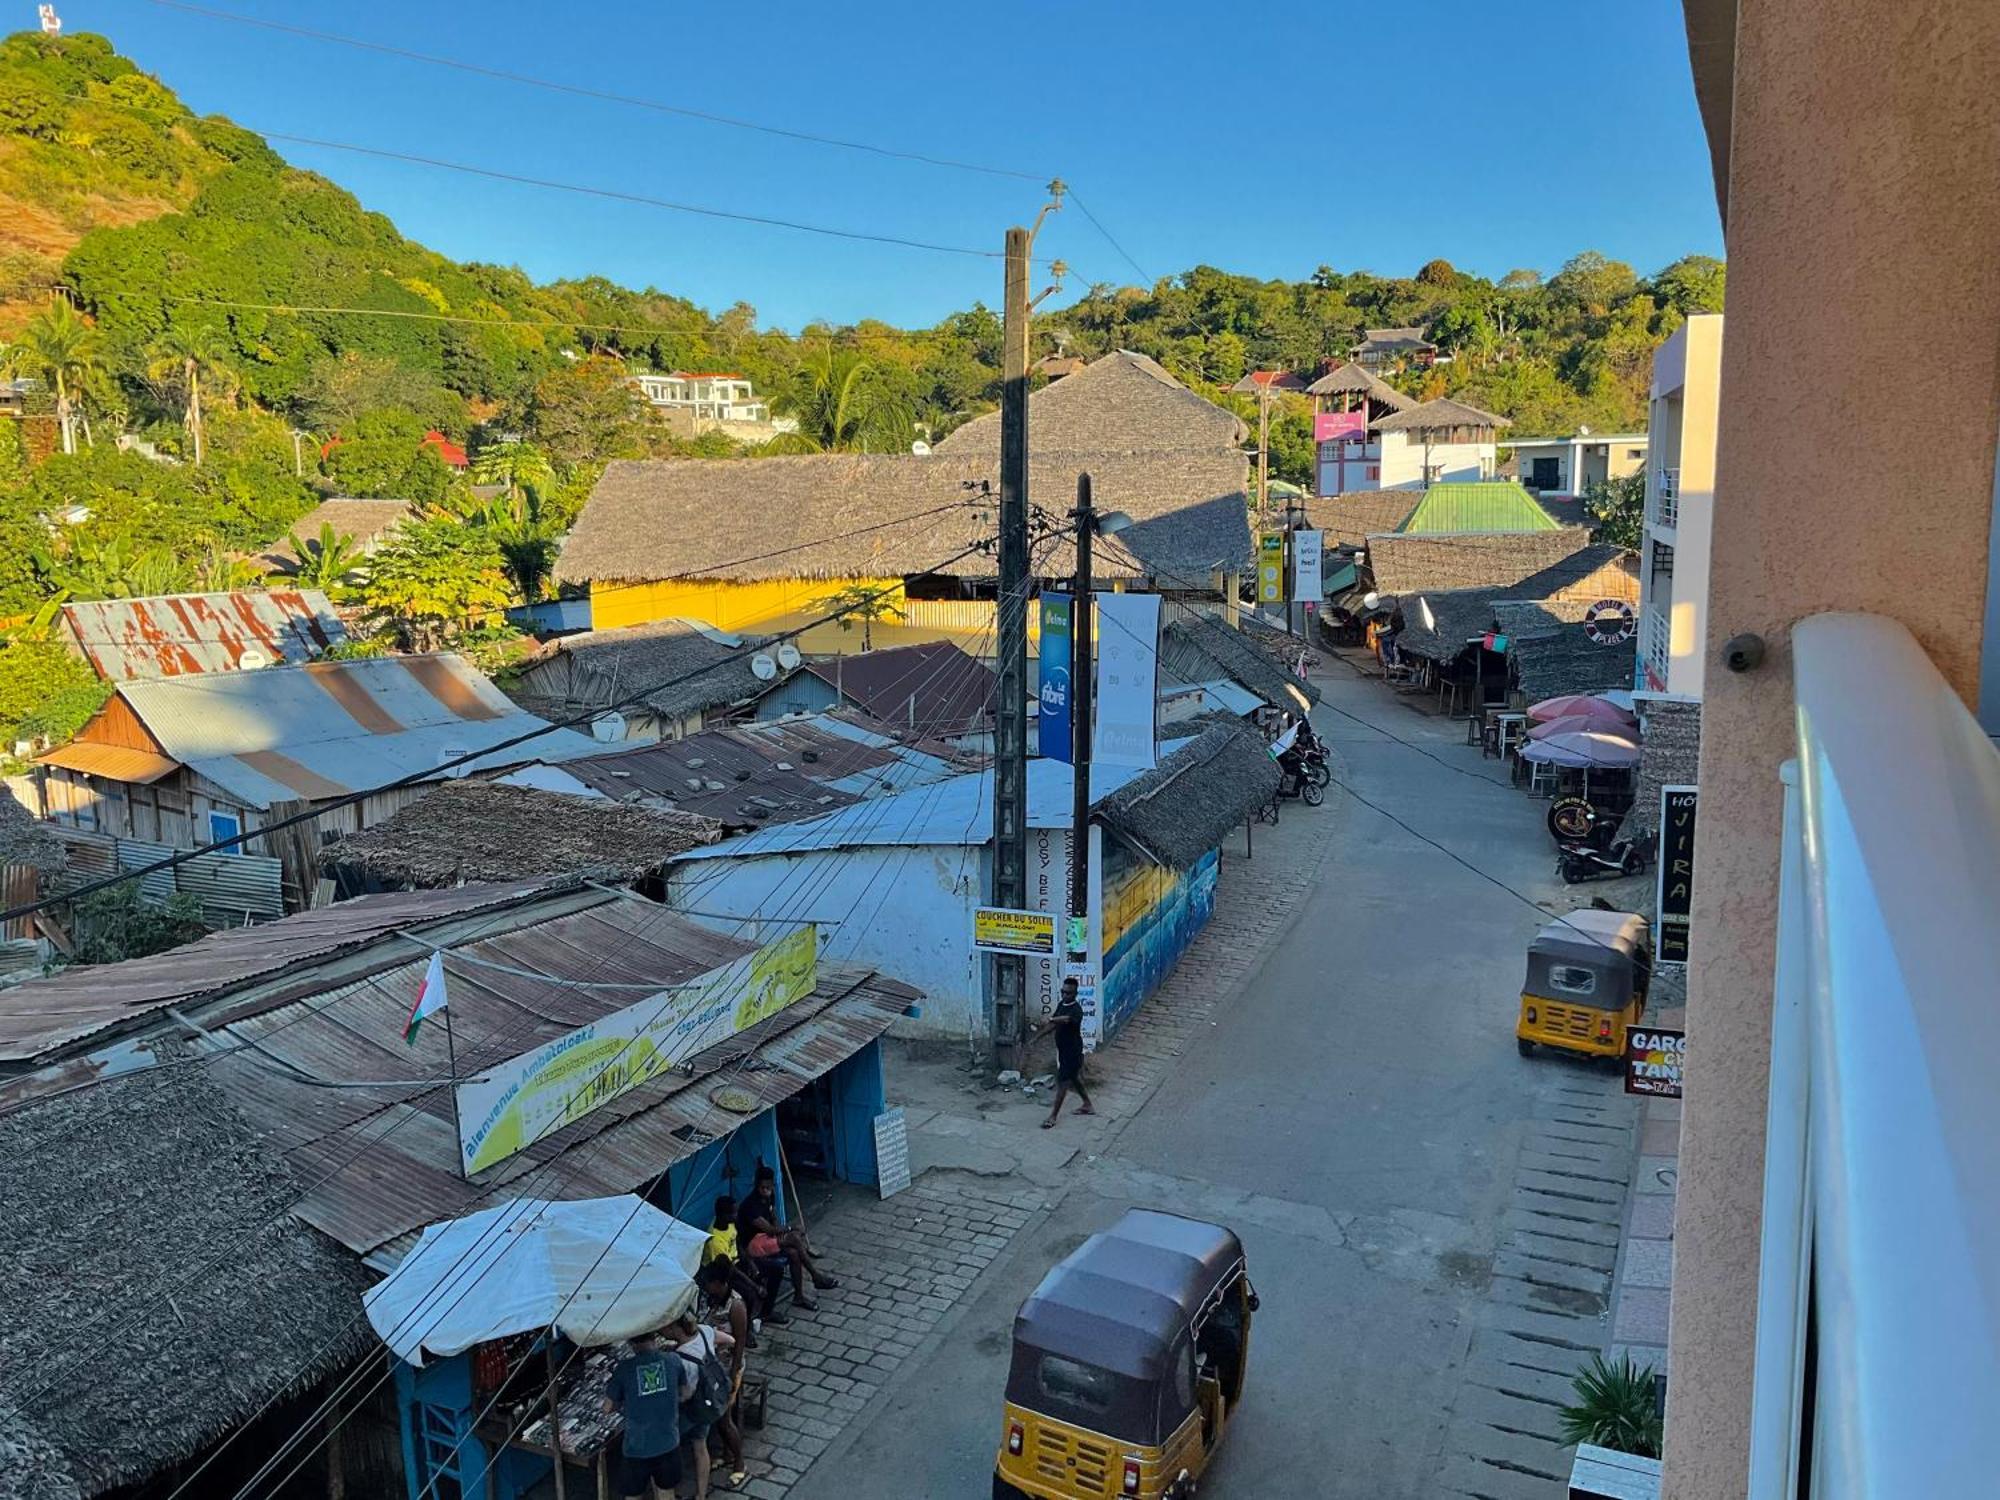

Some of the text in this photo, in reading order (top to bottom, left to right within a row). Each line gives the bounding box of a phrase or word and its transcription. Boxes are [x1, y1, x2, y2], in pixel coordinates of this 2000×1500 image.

[976, 911, 1053, 927] COUCHER DU SOLEIL
[1631, 1032, 1686, 1054] GARG
[1632, 1061, 1685, 1080] TAN
